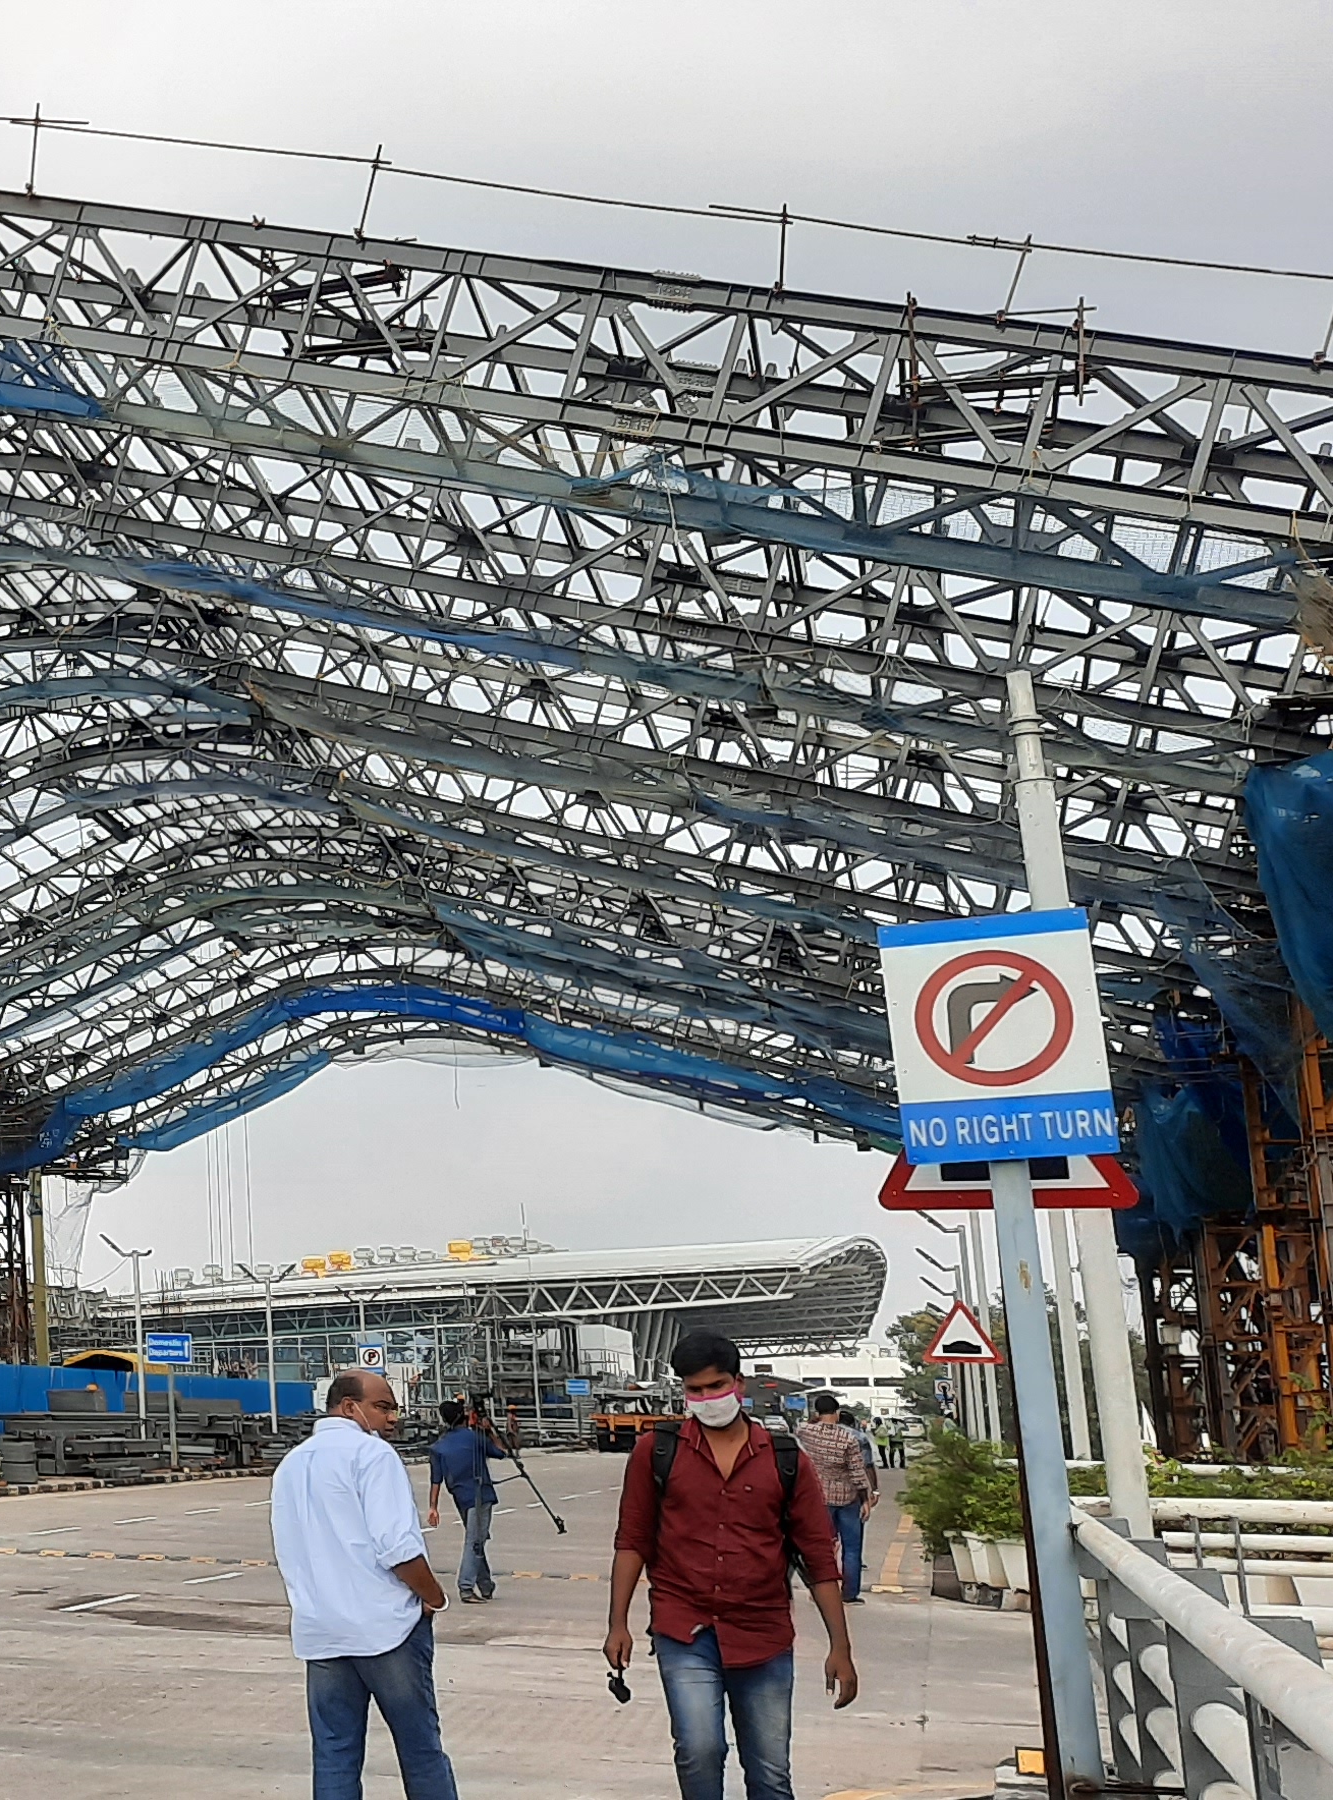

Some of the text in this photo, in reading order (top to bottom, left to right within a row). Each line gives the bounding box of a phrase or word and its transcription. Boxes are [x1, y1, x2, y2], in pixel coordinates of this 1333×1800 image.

[909, 1108, 1114, 1147] NO RIGHT TURN
